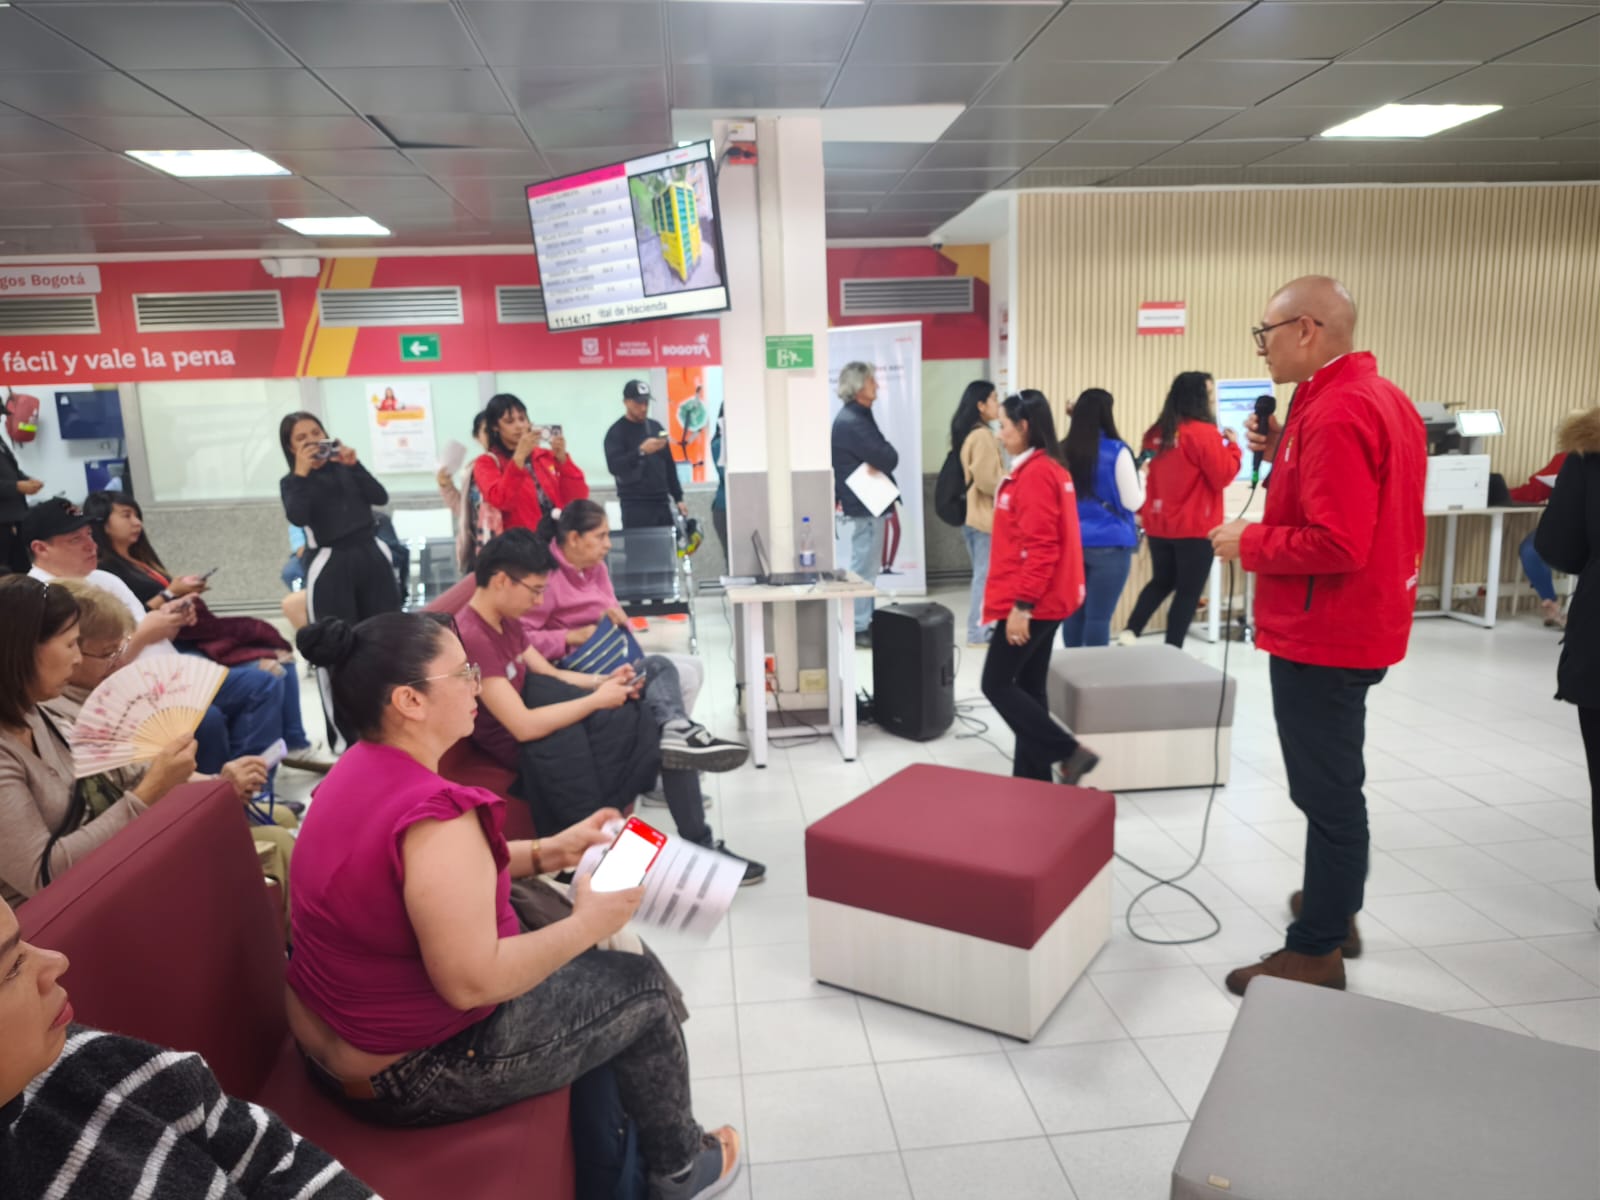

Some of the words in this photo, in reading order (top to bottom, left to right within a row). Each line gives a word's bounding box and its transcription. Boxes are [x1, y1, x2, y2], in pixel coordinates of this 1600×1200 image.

[31, 271, 86, 289] Bogotá
[614, 306, 626, 316] de
[627, 301, 668, 314] Hacienda
[2, 351, 57, 372] fácil
[63, 354, 78, 376] y
[84, 349, 136, 369] vale
[141, 347, 166, 367] la
[172, 349, 236, 372] pena
